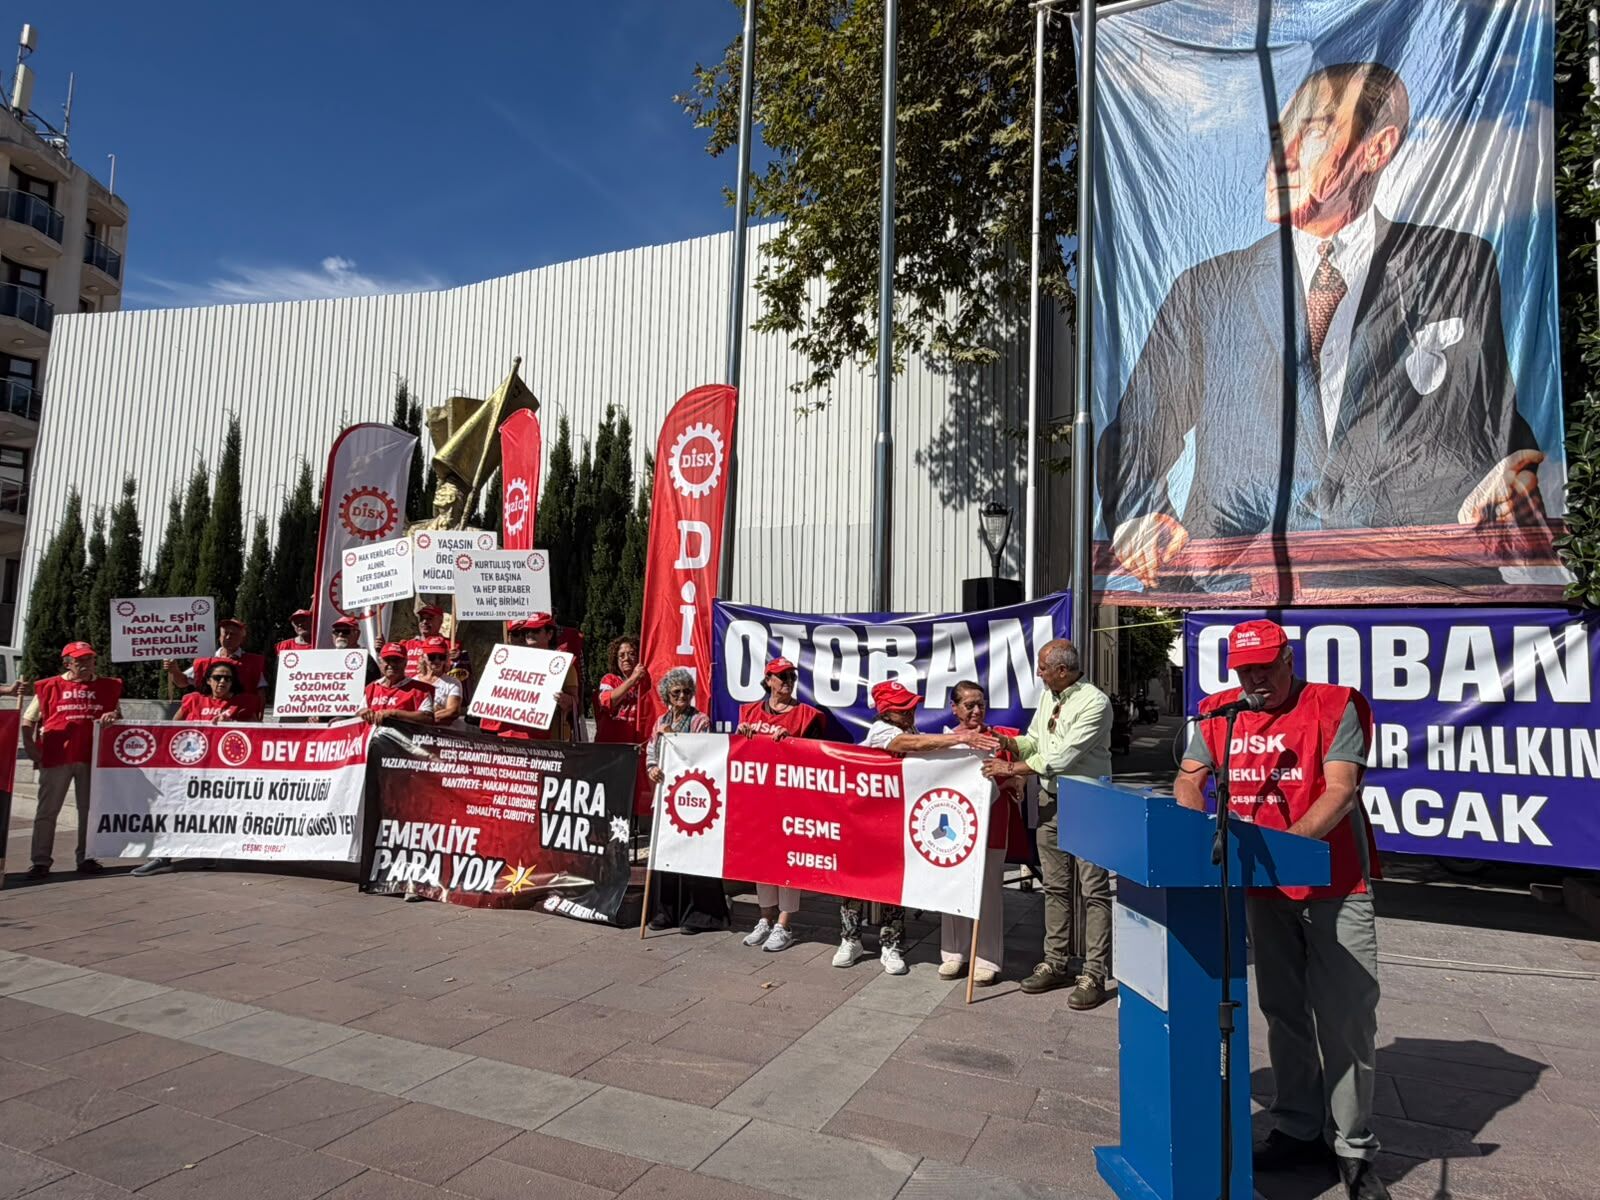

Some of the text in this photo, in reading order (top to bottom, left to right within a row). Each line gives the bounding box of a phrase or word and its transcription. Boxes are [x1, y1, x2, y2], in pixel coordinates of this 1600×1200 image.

[681, 448, 714, 468] DİSK
[352, 502, 385, 520] DİSK
[437, 539, 473, 551] YAŞASIN
[358, 554, 369, 562] HAK
[370, 547, 395, 559] VERİLMEZ
[435, 552, 454, 565] ÖRG
[474, 560, 511, 571] KURTULUŞ
[512, 560, 527, 569] YOK
[356, 568, 398, 583] ZAFER SOKAKTA
[480, 573, 521, 583] TEK BAŞINA
[472, 585, 531, 593] YA HEP BERABER
[475, 598, 485, 606] YA
[485, 596, 498, 607] HİÇ
[499, 596, 525, 606] BİRİMİZ
[169, 612, 196, 624] EŞİT
[122, 622, 206, 635] İNSANCA BİR
[131, 634, 199, 646] EMEKLİLİK
[132, 646, 198, 657] İSTİYORUZ
[406, 648, 424, 656] DİS
[724, 615, 1054, 710] OTOBAN
[1198, 623, 1592, 704] OOBAN
[288, 671, 354, 680] SÖYLEYECEK
[498, 668, 547, 686] SEFALETE
[62, 688, 96, 700] DİSK
[294, 682, 346, 691] SÖZÜMÜZ
[490, 685, 541, 704] MAHKUM
[288, 694, 350, 703] YAŞAYACAK
[371, 696, 398, 706] DİSK
[277, 703, 332, 713] GÜNÜMÜZ
[471, 701, 549, 726] OLMAYACAĞIZ!
[261, 740, 301, 762] DEV
[1229, 731, 1287, 755] DİSK
[439, 749, 458, 763] GEÇİŞ
[458, 751, 491, 764] GARANTİLİ
[1427, 724, 1600, 779] HALKIN
[472, 766, 498, 779] YANDAŞ
[498, 768, 539, 783] CEMAATLERE
[730, 760, 900, 799] DEV EMEKLİ-SEN
[1270, 768, 1303, 781] SEN
[186, 775, 332, 802] ÖRGÜTLÜ KÖTÜLÜĞÜ
[509, 784, 538, 796] ARACINA
[492, 793, 537, 810] FAİZ LOBİSİNE
[540, 777, 605, 818] PARA
[677, 790, 707, 809] DİSK
[97, 813, 168, 834] ANCAK
[173, 814, 238, 834] HALKIN
[242, 811, 307, 836] ÖRGÜTLÜ
[306, 811, 337, 836] GÜCÜ
[1361, 785, 1553, 847] ACAK
[782, 815, 841, 840] ÇEŞME
[375, 818, 481, 856] EMEKLİYE
[786, 851, 838, 871] ŞUBESİ
[369, 849, 441, 886] PARA
[450, 855, 504, 893] YOK
